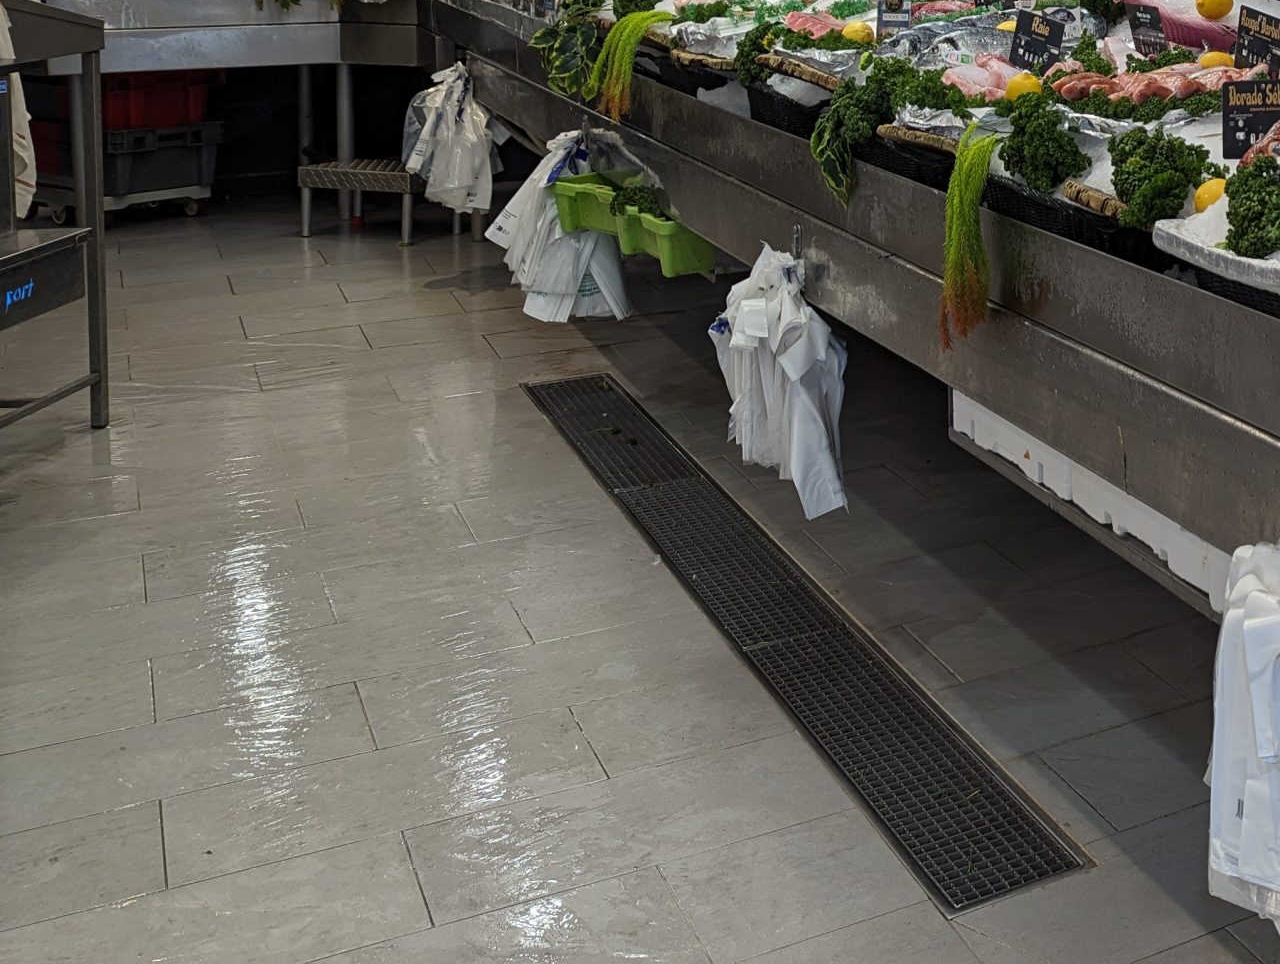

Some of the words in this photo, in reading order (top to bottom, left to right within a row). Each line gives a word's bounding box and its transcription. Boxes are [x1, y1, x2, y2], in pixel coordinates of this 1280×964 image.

[1031, 16, 1050, 36] Raie
[1241, 9, 1260, 35] Rouget
[1260, 15, 1280, 40] Barbet
[1229, 84, 1263, 106] Dorade
